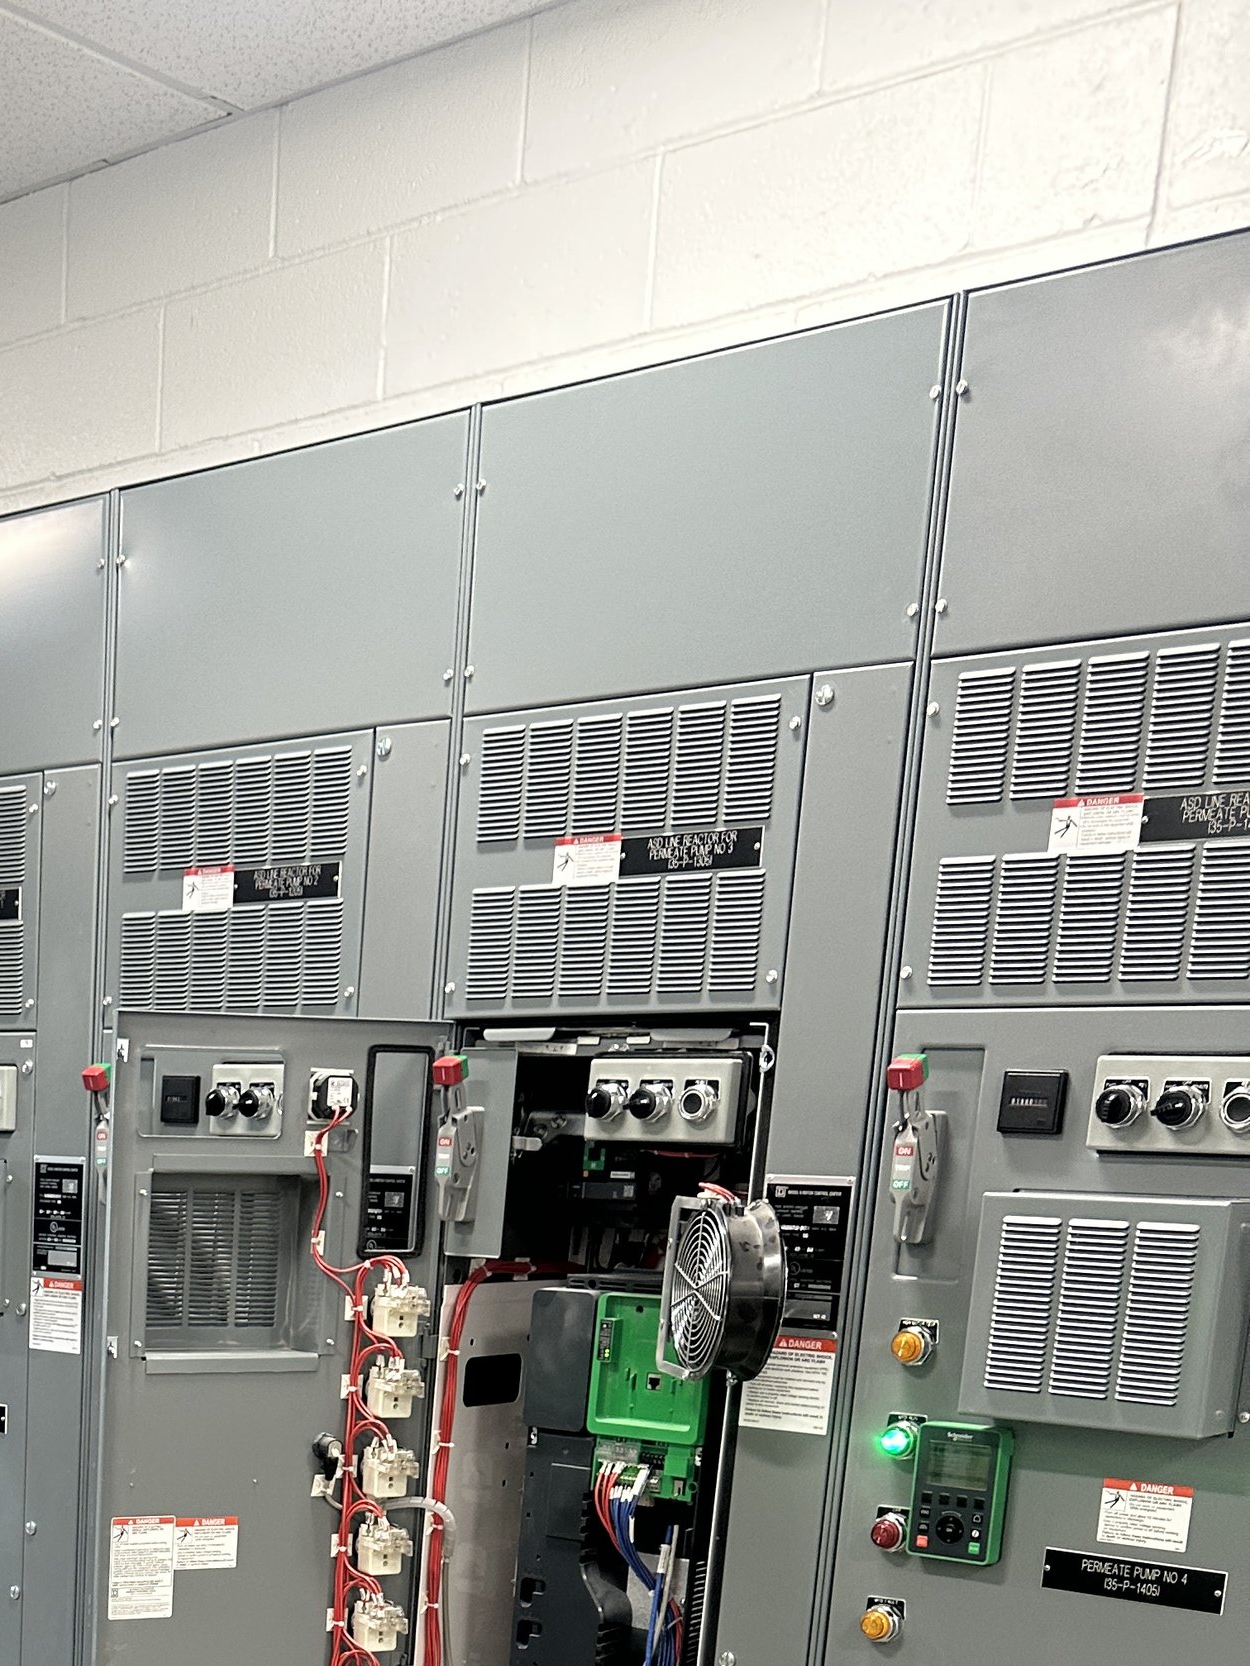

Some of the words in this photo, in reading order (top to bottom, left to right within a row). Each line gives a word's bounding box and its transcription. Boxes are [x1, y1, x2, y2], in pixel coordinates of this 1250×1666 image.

[1087, 796, 1120, 807] DANGER
[1180, 796, 1201, 811] ASD
[1205, 793, 1227, 808] LINE
[1181, 806, 1237, 823] PERMEATE
[647, 837, 664, 849] ASD
[665, 835, 681, 848] LINE
[682, 832, 719, 847] REACTOR
[721, 830, 738, 843] FOR
[649, 846, 689, 861] PERMEATE
[690, 844, 712, 858] PUMP
[713, 842, 726, 855] NO
[727, 841, 734, 854] 3
[280, 866, 308, 879] REACTOR
[309, 864, 322, 876] FOR
[897, 1147, 912, 1155] ON
[892, 1180, 910, 1189] OFF
[788, 1340, 822, 1350] DANGER
[1140, 1483, 1174, 1495] DANGER
[202, 1518, 226, 1526] DANGER
[1081, 1558, 1131, 1578] PERMEATE
[1133, 1566, 1161, 1582] PUMP
[1163, 1570, 1178, 1585] NO
[1181, 1573, 1188, 1585] 4
